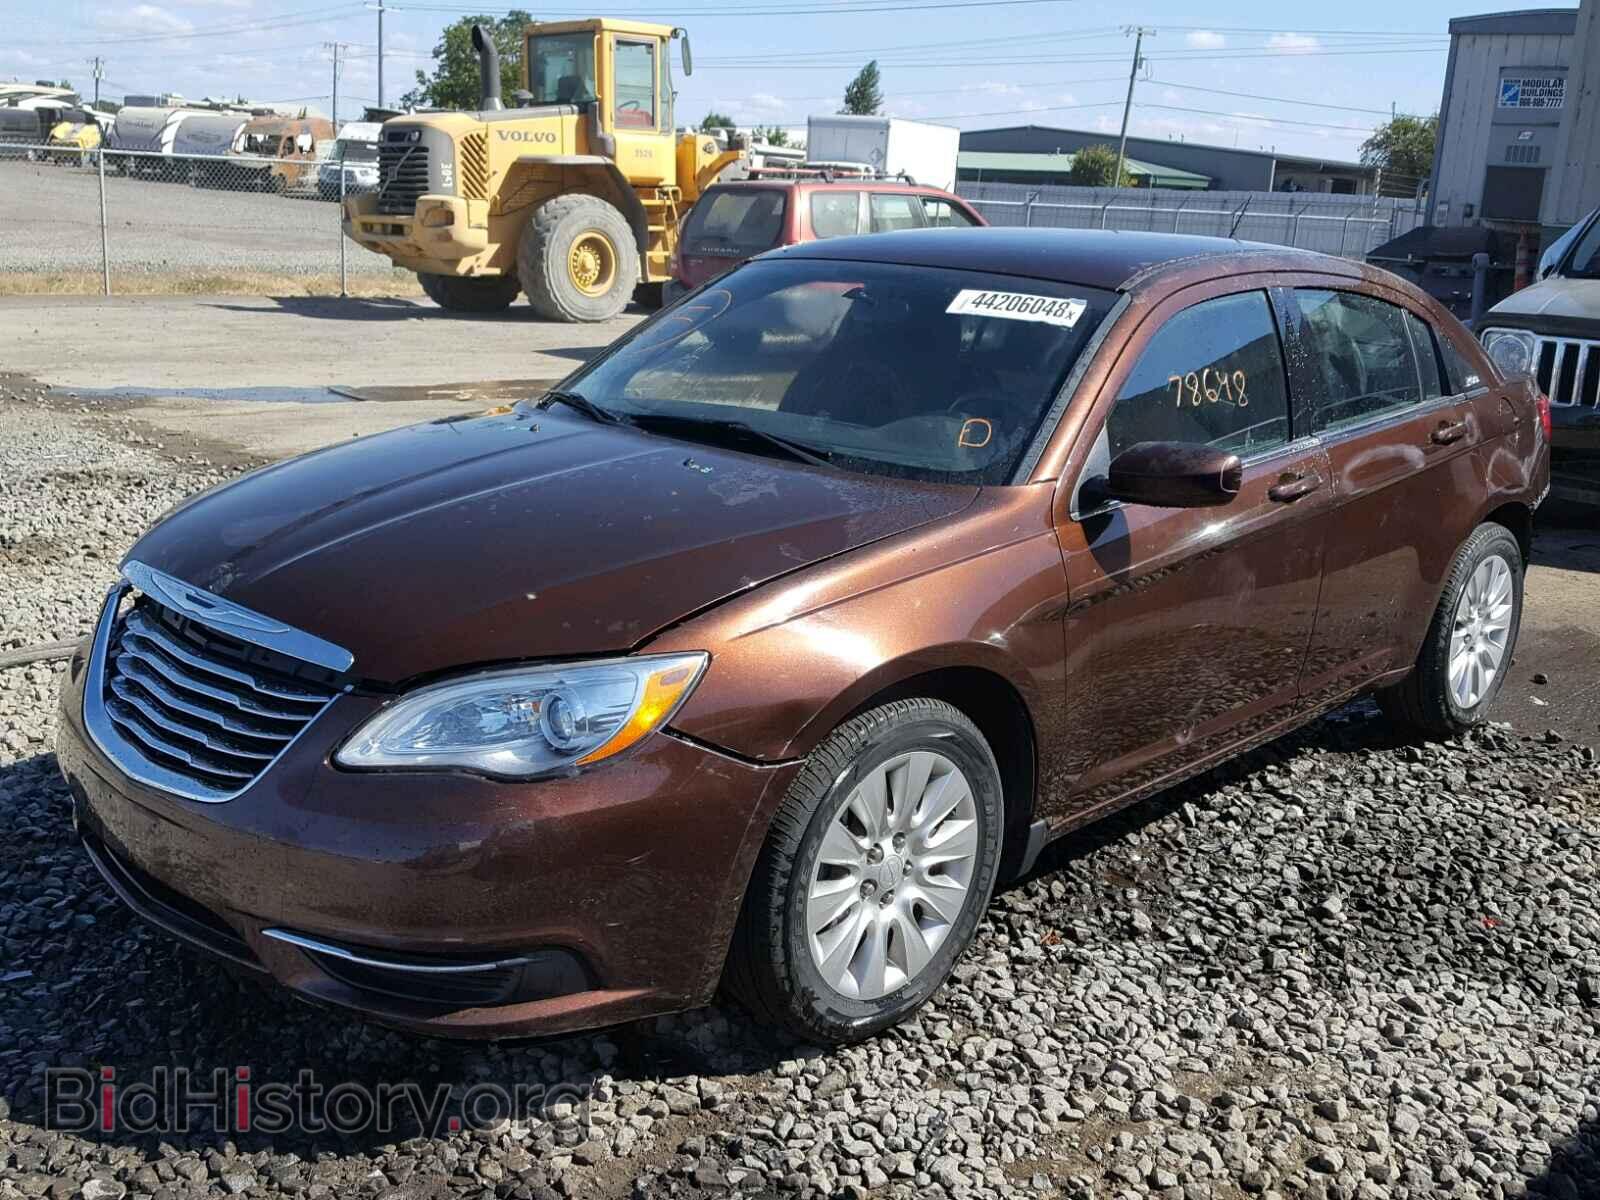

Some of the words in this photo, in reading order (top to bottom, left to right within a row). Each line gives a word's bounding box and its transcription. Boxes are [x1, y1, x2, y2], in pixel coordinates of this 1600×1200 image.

[1522, 79, 1565, 88] MODULAR
[1520, 88, 1564, 97] BUILDINGS
[496, 130, 557, 143] VOLVO
[1167, 367, 1249, 407] 78648
